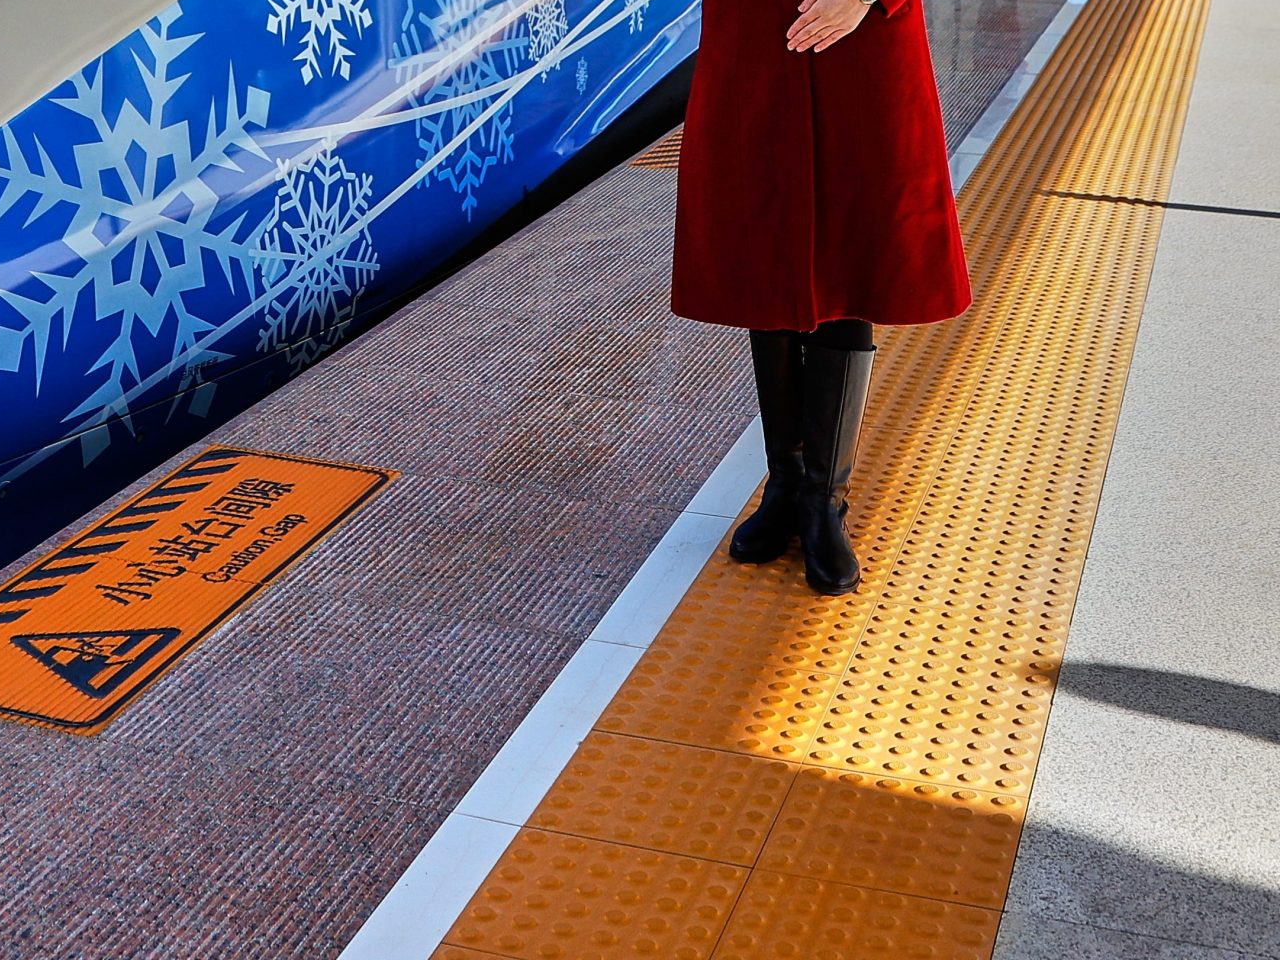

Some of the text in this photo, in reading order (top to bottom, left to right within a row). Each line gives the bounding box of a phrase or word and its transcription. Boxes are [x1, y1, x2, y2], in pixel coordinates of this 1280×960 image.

[95, 478, 295, 606] 小心站台间隙
